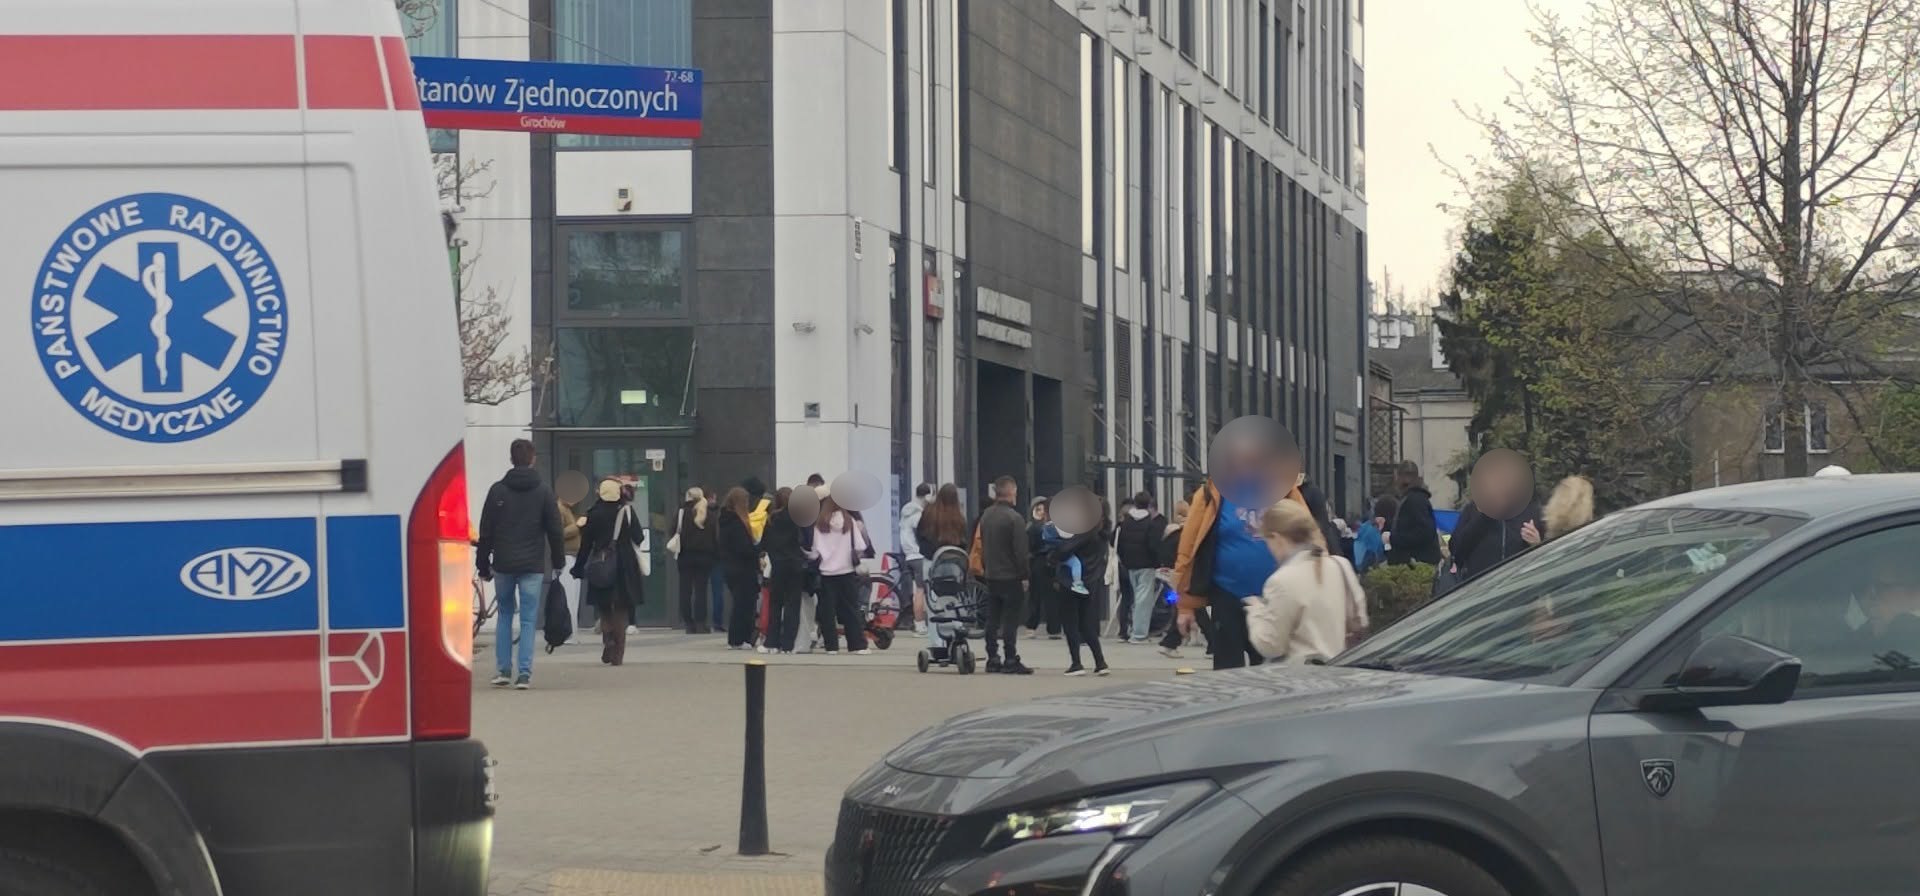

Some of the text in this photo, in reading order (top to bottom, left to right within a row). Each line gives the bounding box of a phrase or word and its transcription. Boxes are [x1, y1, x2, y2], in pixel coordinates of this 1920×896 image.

[414, 74, 678, 118] tanów Zjednoczonych
[520, 115, 566, 129] Grochów
[36, 200, 283, 380] PAŃSTWOWE RATOWNICTWO
[80, 386, 243, 435] MEDYCZNE
